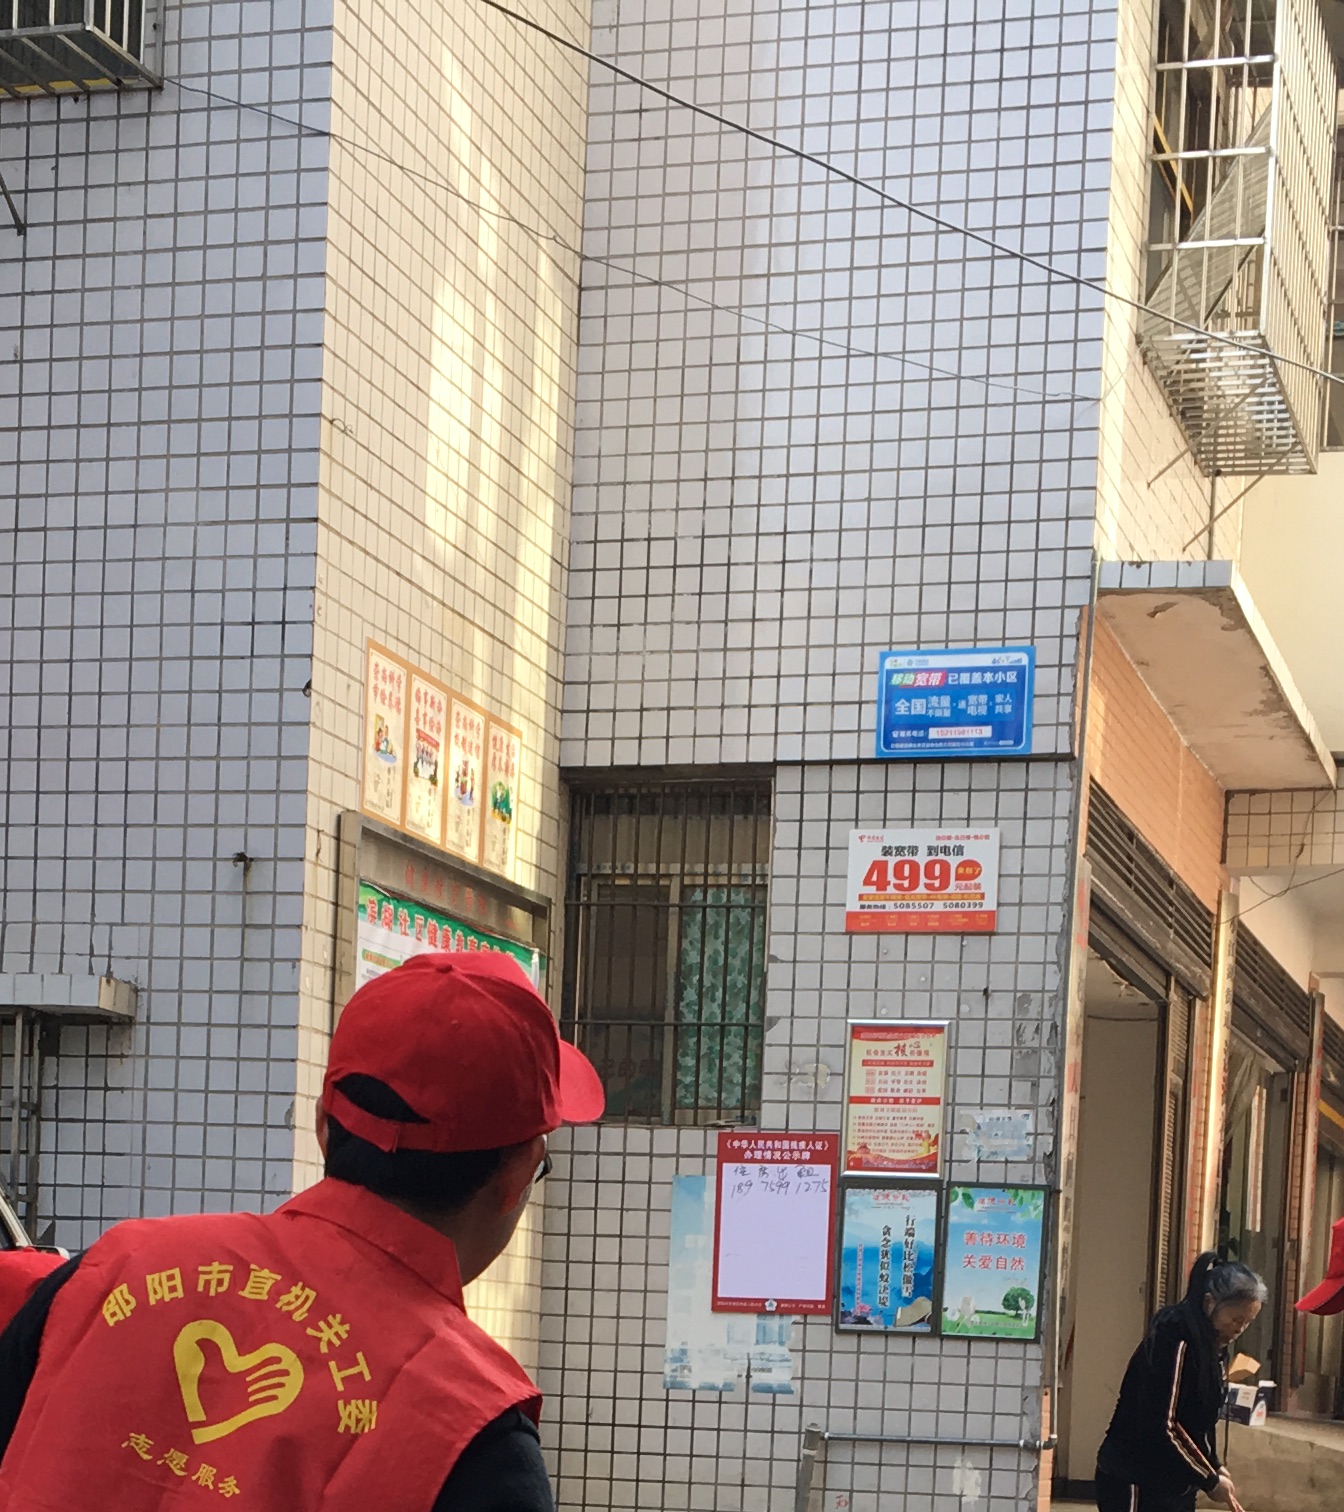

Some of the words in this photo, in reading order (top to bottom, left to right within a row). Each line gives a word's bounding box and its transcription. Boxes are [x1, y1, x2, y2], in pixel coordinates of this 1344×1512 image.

[947, 671, 1018, 685] 已覆盖本小区
[894, 698, 927, 716] 全国
[881, 845, 919, 857] 装宽带
[926, 844, 965, 857] 到电信
[862, 858, 952, 893] 499
[730, 1179, 754, 1199] 189
[760, 1180, 791, 1196] 7599
[795, 1178, 829, 1194] 1275
[963, 1230, 1027, 1249] 善待环境
[962, 1254, 1025, 1271] 关爱自然
[101, 1261, 378, 1435] 邵阳市直机关工委
[121, 1431, 241, 1499] 志愿服务
